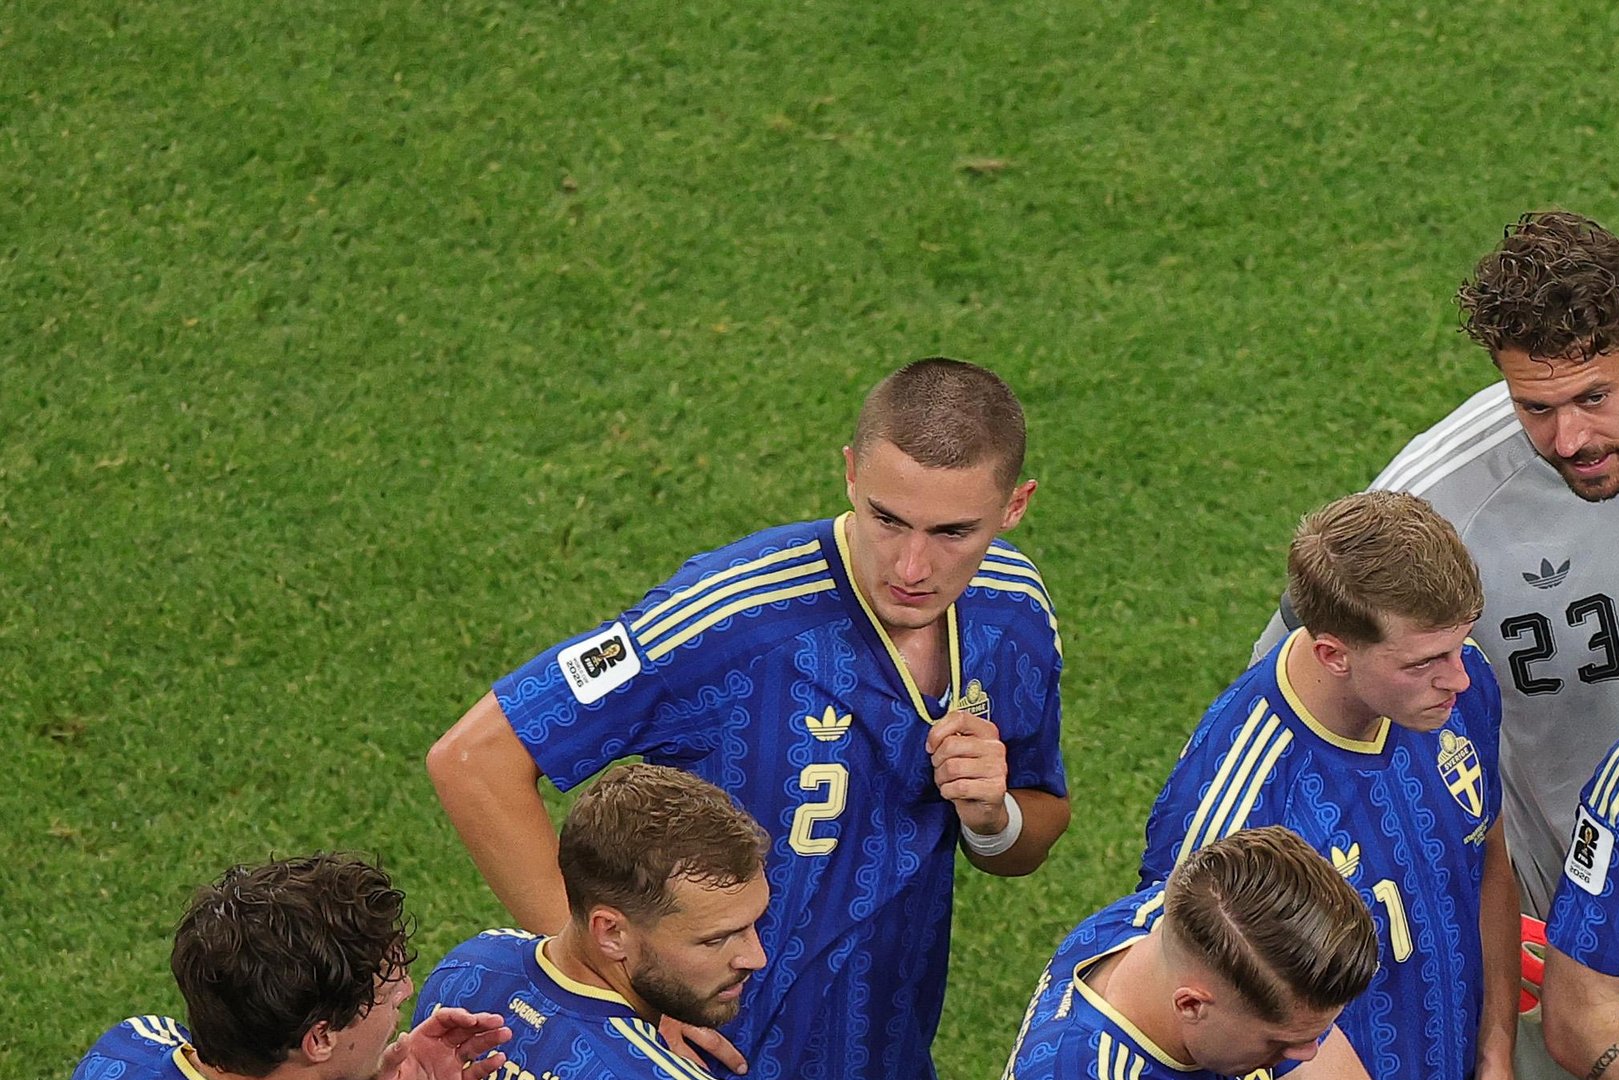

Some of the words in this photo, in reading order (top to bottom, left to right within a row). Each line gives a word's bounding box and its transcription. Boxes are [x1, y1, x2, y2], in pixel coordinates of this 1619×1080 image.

[566, 660, 584, 688] 2026
[1444, 747, 1469, 771] SVERIGE
[788, 763, 849, 857] 2
[1372, 878, 1413, 963] 1
[509, 998, 548, 1030] SVERIGE
